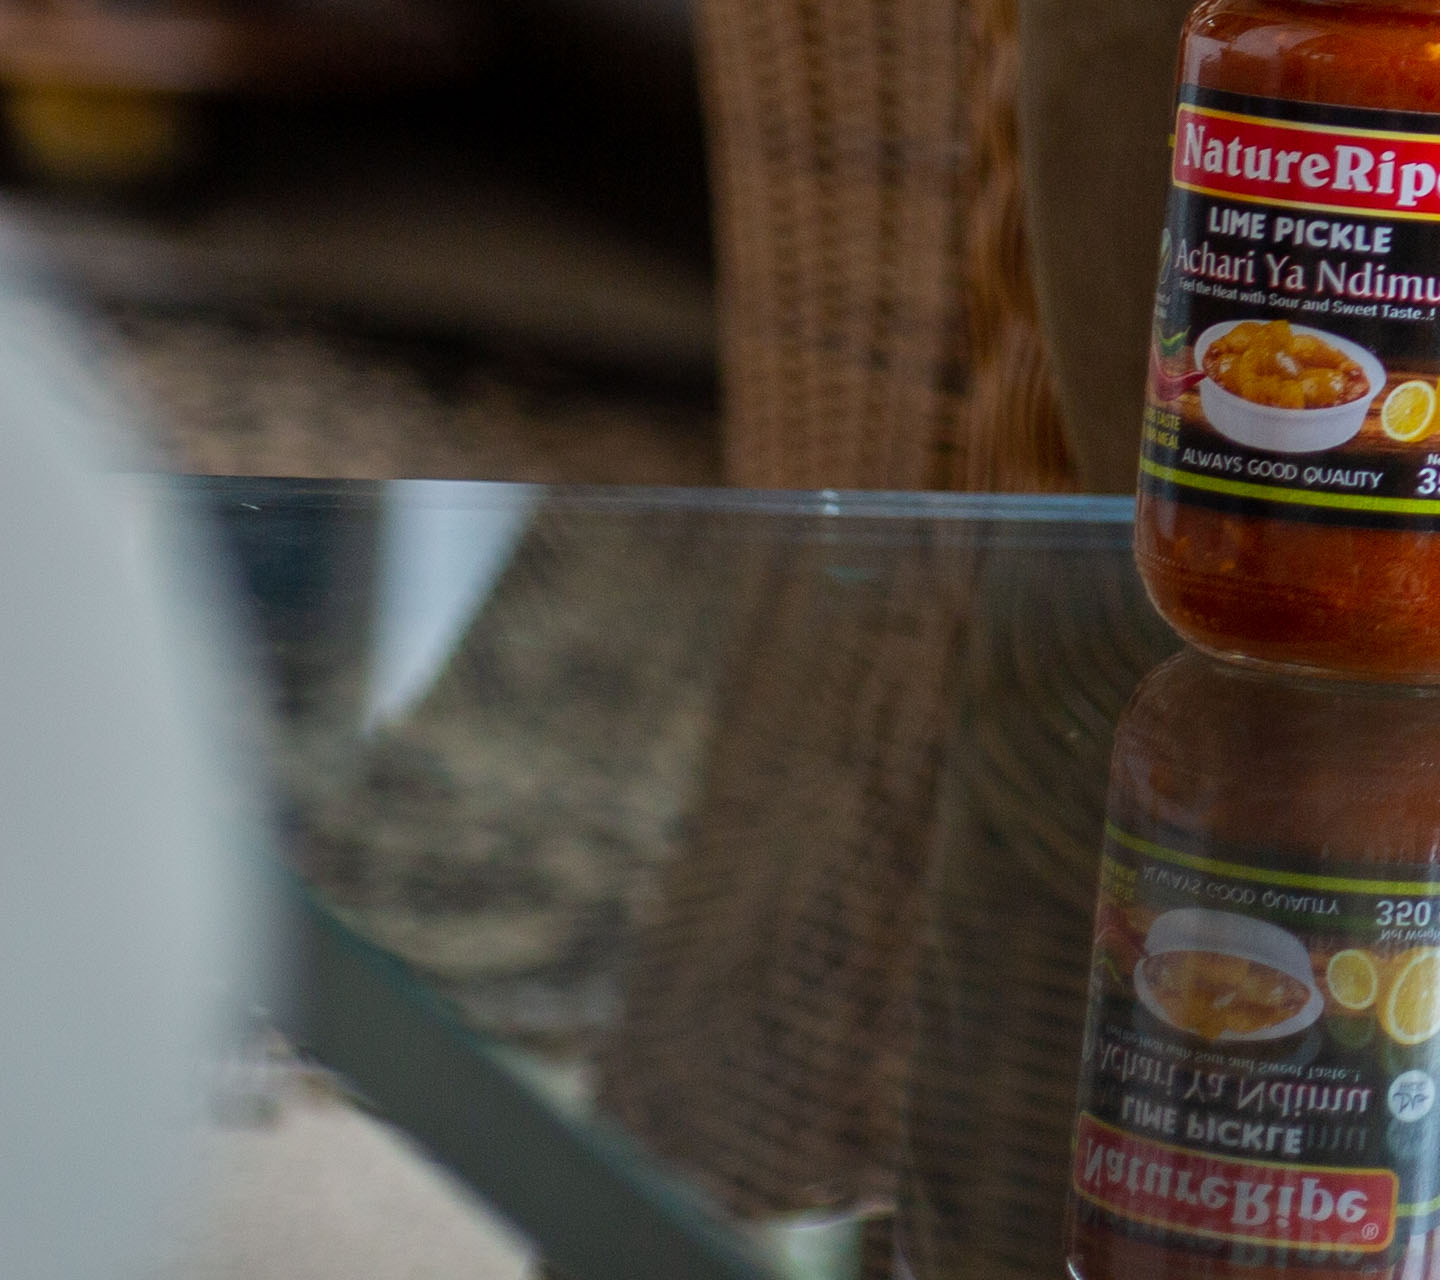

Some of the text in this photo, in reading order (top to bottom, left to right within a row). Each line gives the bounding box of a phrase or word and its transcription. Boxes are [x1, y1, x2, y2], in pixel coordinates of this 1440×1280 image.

[1209, 206, 1394, 254] LIME PICKLE
[1175, 238, 1256, 283] Achari
[1265, 253, 1306, 291] Ya
[1212, 283, 1238, 300] Heat
[1239, 290, 1266, 305] with
[1268, 292, 1300, 309] Sour
[1303, 299, 1330, 313] and
[1332, 300, 1378, 317] Sweet
[1182, 447, 1384, 488] ALWAYS GOOD QUALITY
